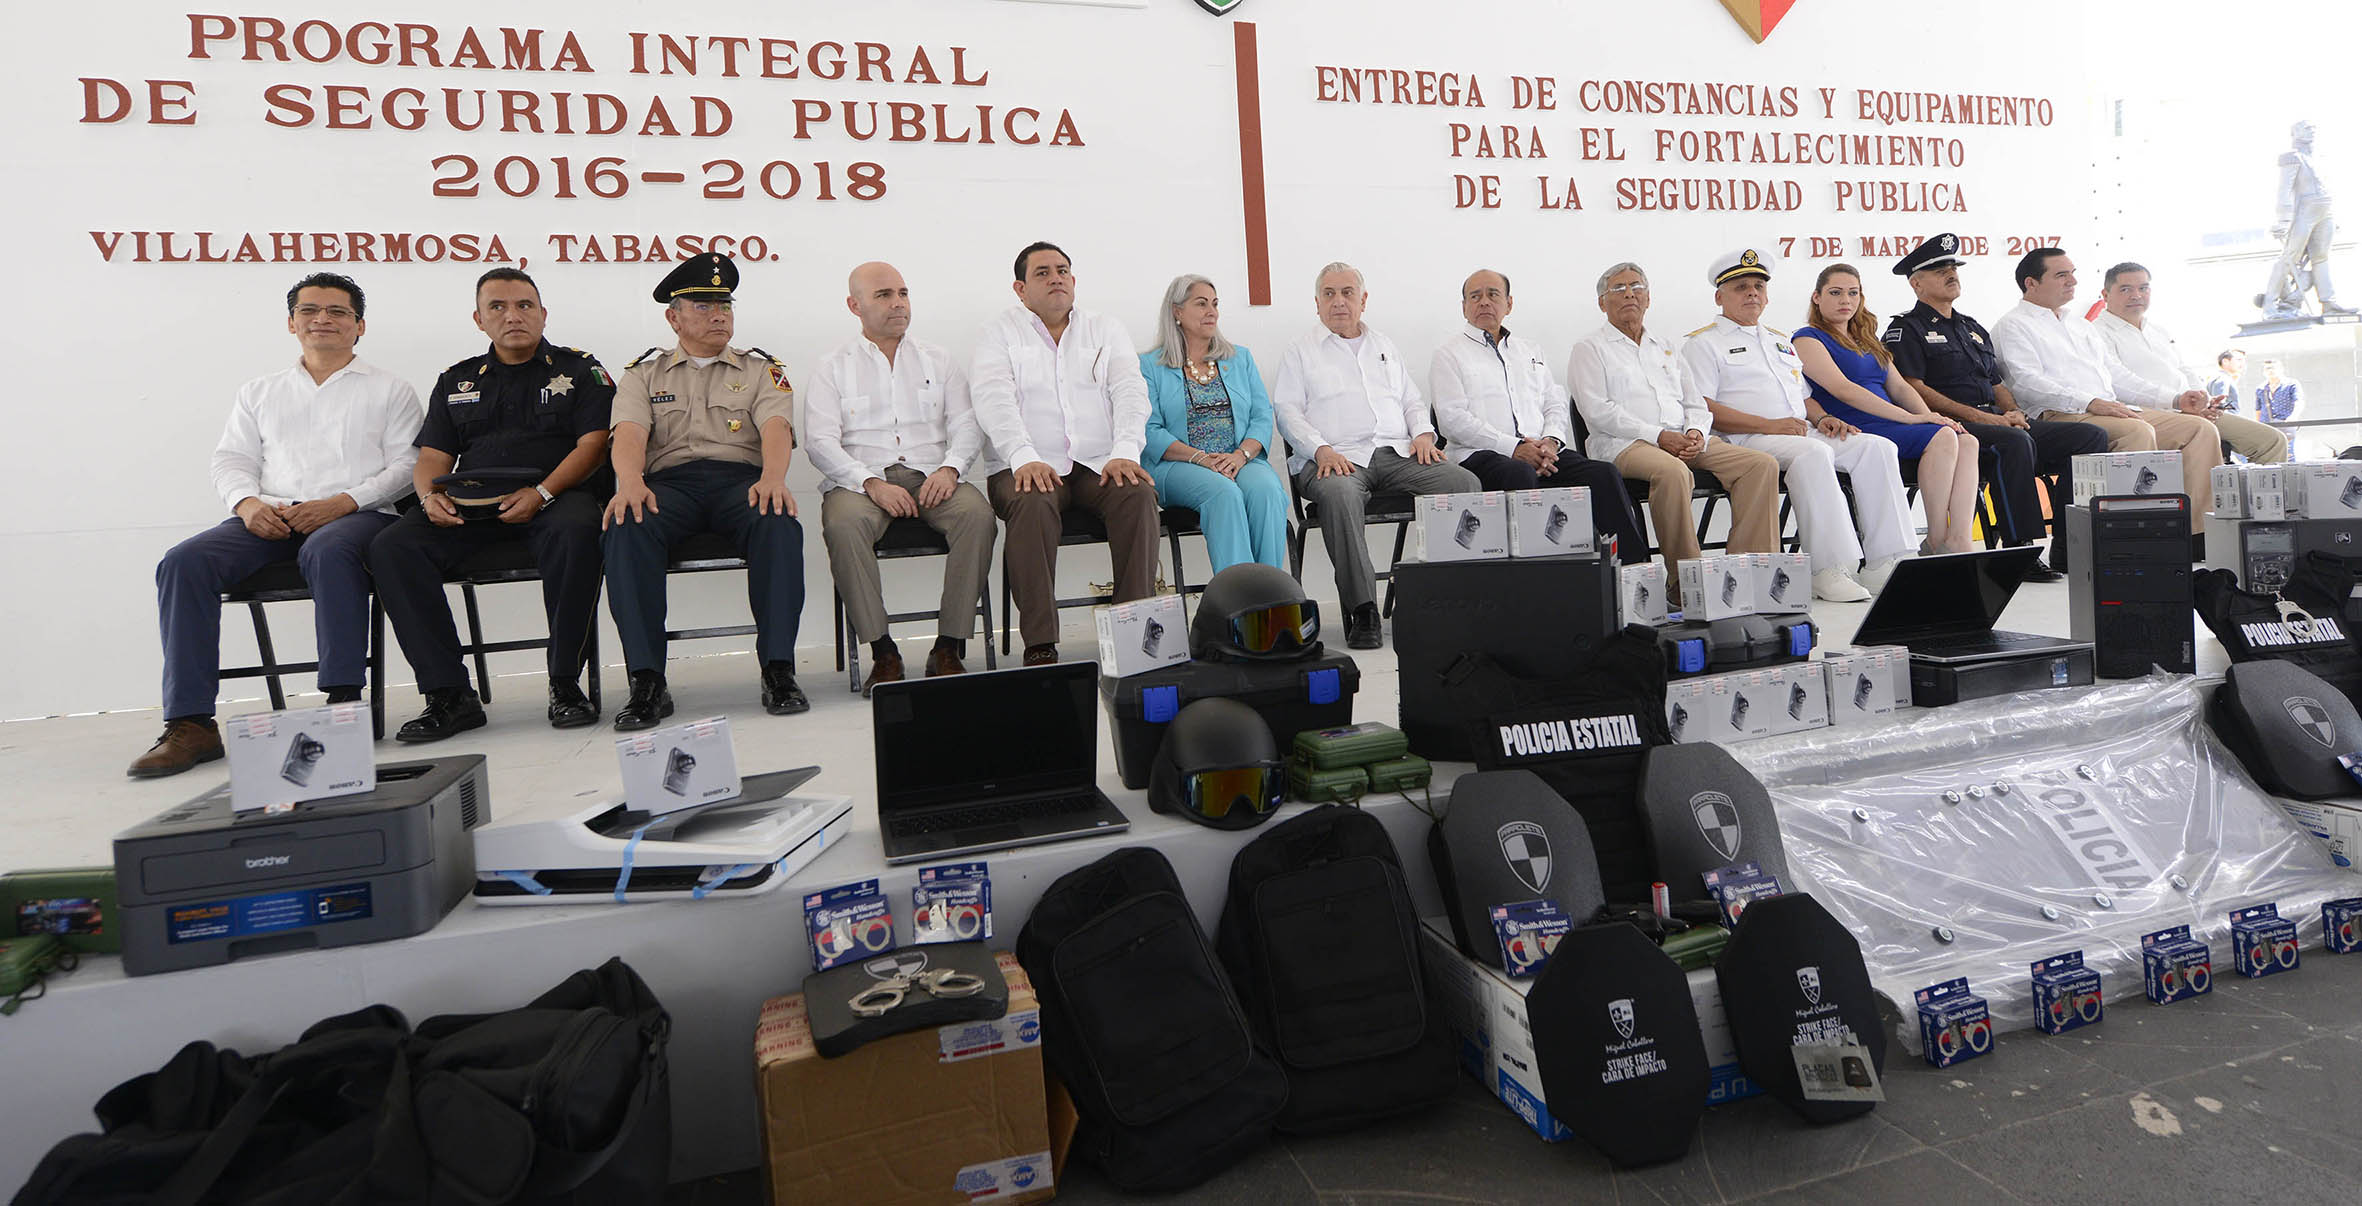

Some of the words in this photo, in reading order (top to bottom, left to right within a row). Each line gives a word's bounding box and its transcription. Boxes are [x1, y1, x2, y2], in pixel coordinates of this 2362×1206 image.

[187, 13, 595, 73] PROGRAMA
[629, 31, 989, 88] INTEGRAL
[79, 77, 198, 126] DE
[264, 83, 735, 137] SEGURIDAD
[791, 98, 1087, 148] PUBLICA
[1316, 65, 1486, 110] ENTREGA
[1511, 75, 1557, 111] DE
[1579, 79, 1799, 119] CONSTANCIAS
[1819, 87, 1836, 119] Y
[1858, 88, 2055, 128] EQUIPAMIENTO
[1448, 123, 1548, 159] PARA
[1580, 127, 1626, 162] EL
[1655, 129, 1966, 168] FORTALECIMIENTO
[431, 154, 887, 202] 2016-2018
[1455, 174, 1502, 210] DE
[1538, 175, 1584, 211] LA
[1616, 177, 1803, 212] SEGURIDAD
[1835, 181, 1968, 213] PUBLICA
[90, 231, 529, 271] VILLAHERMOSA,
[548, 233, 781, 263] TABASCO.
[1778, 236, 1798, 258] 7
[1810, 236, 1843, 258] DE
[1859, 235, 1926, 258] MARZ
[1958, 236, 1989, 257] DE
[2240, 620, 2296, 648] POLICIA
[1499, 720, 1573, 757] POLICIA
[1569, 713, 1642, 750] ESTATAL
[245, 854, 290, 869] brother
[1792, 1033, 1813, 1047] CARA
[1797, 1020, 1823, 1035] STRIKE
[1601, 1070, 1625, 1084] CARA
[1623, 1067, 1636, 1080] DE
[1634, 1058, 1667, 1078] IMPACTO
[1606, 1055, 1636, 1072] STRIKE
[1634, 1050, 1658, 1067] FACE/
